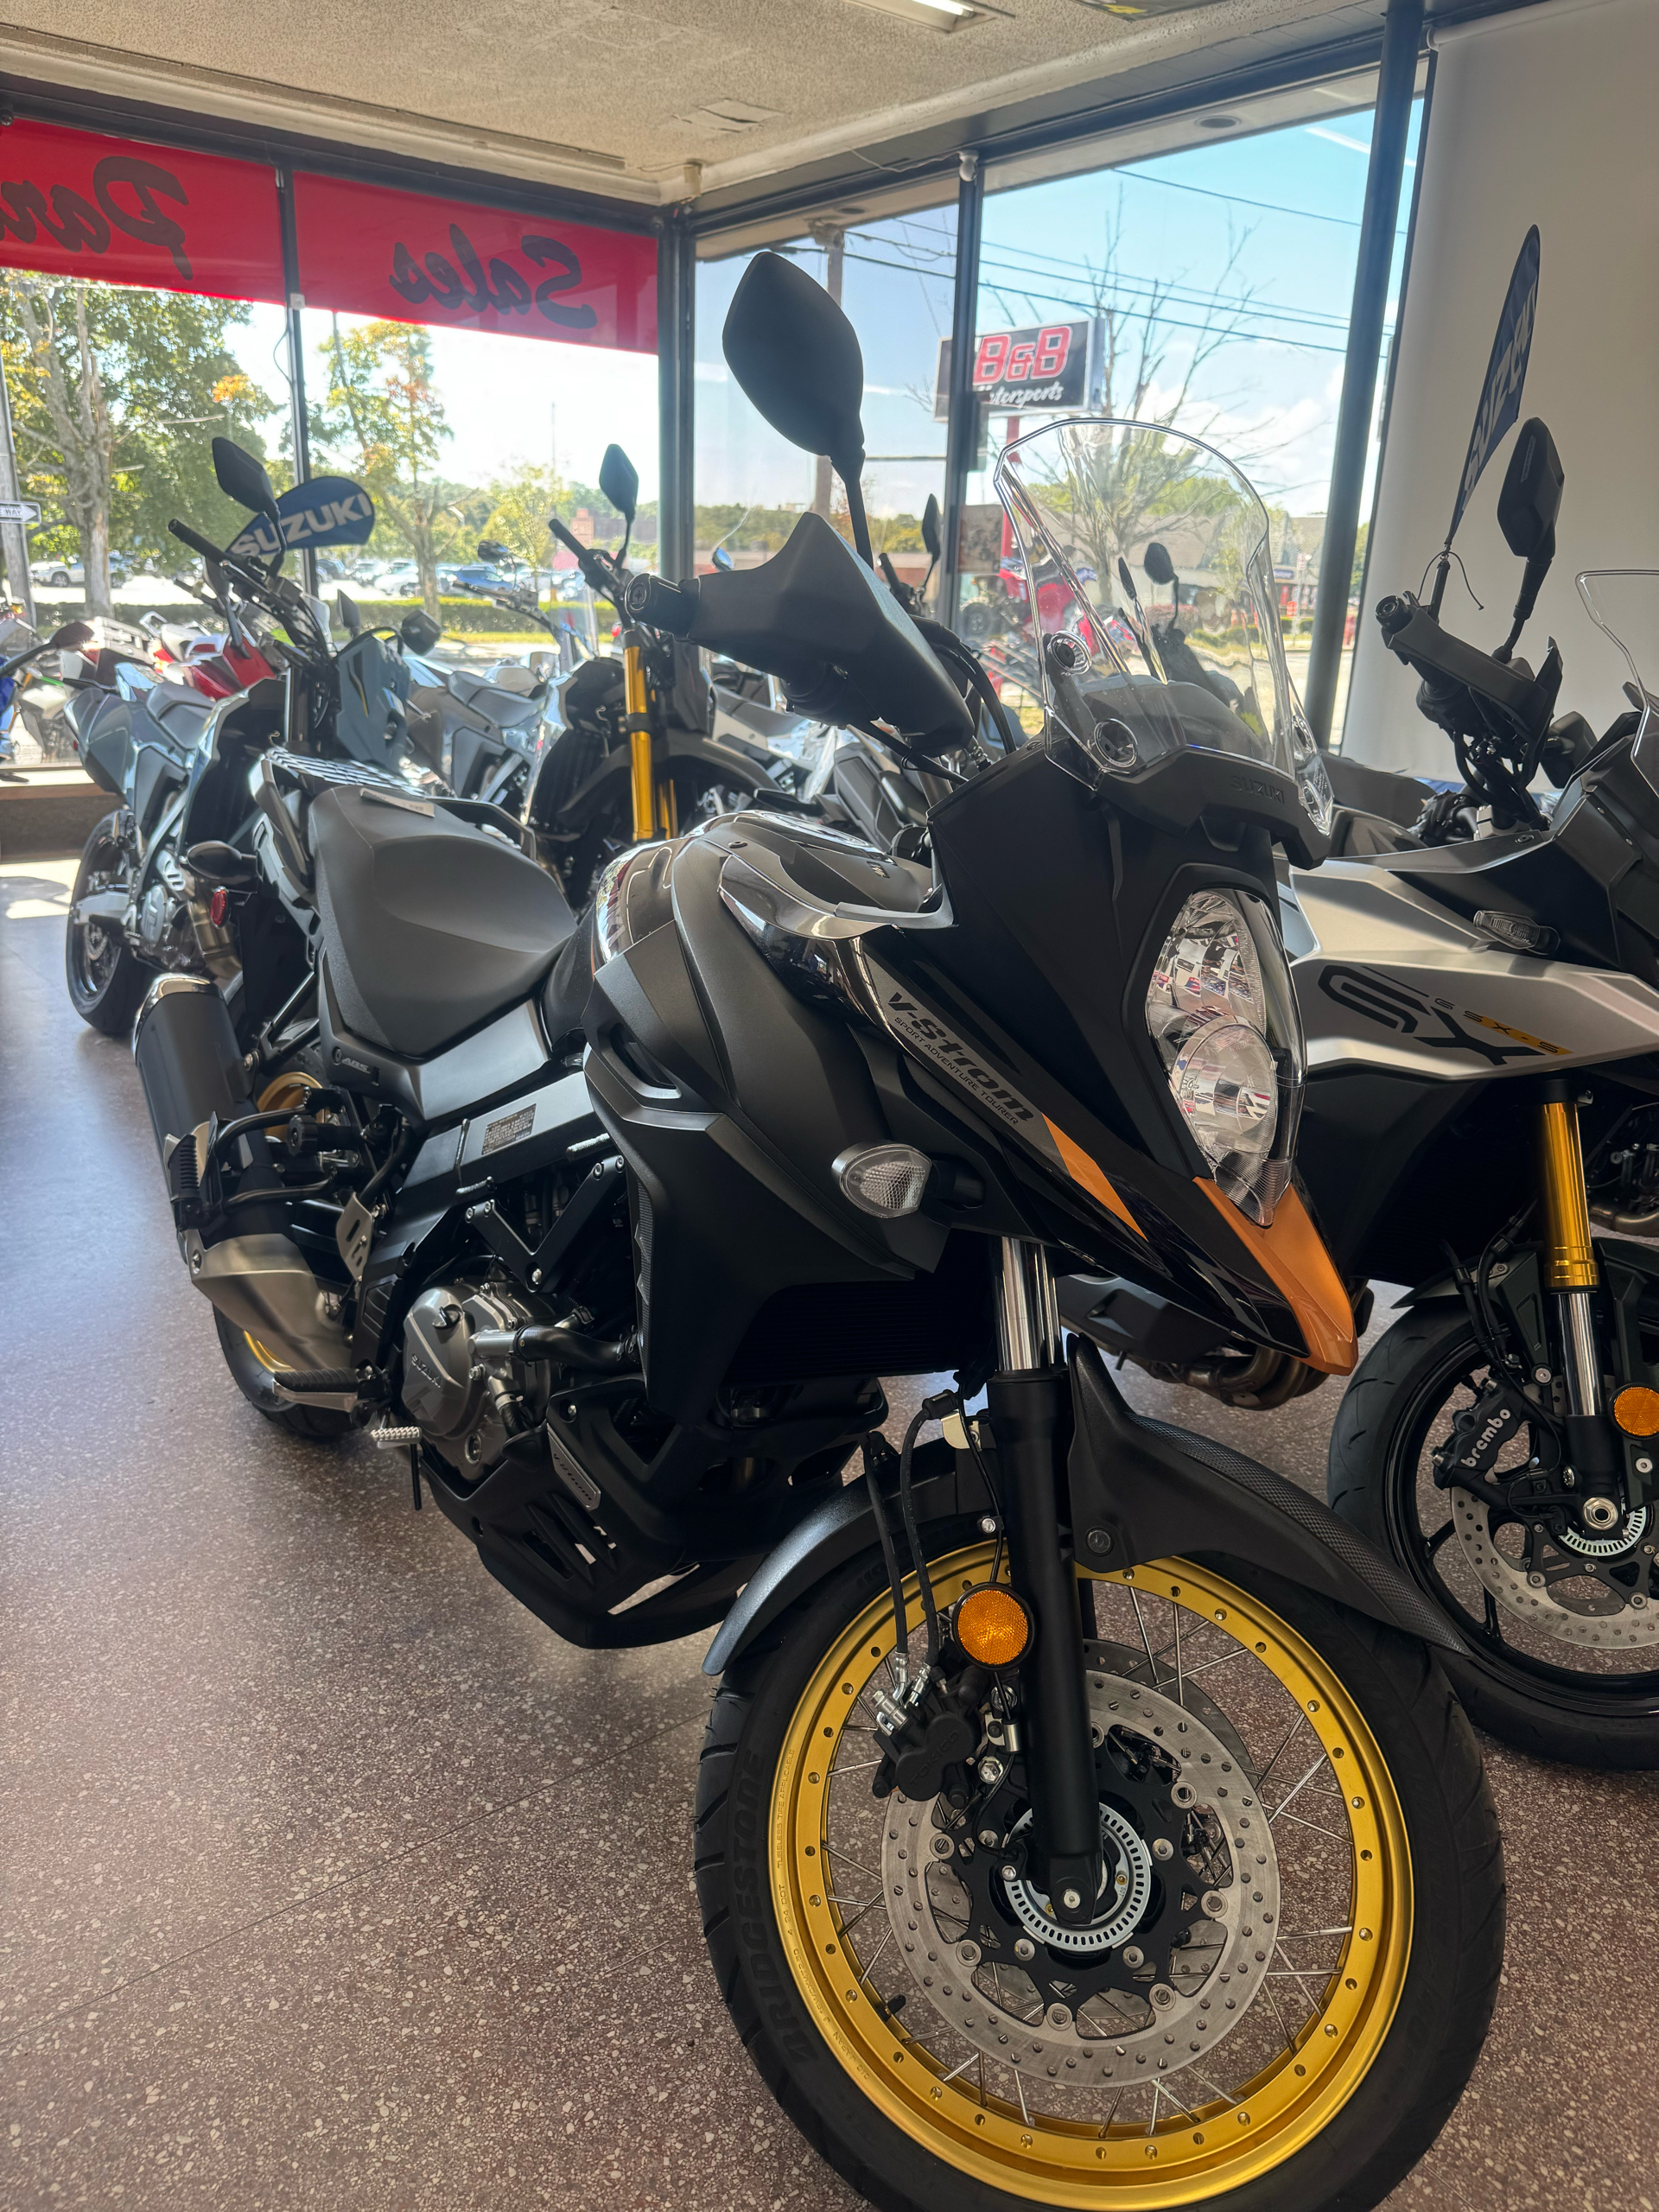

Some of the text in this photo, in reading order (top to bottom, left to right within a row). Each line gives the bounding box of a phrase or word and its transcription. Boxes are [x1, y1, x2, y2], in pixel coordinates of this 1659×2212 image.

[973, 326, 1073, 385] B&B
[978, 381, 1065, 410] torsports
[222, 493, 373, 558] SUZUKI
[1230, 775, 1286, 804] SUZUKI
[342, 1058, 371, 1074] ABS
[887, 992, 1034, 1122] V-Strom
[894, 1017, 1019, 1125] SPORT ADVENTURE TOURER
[1460, 1408, 1510, 1467] brembo
[779, 1749, 795, 1799] APPLICABLE
[910, 1731, 958, 1786] TOKICO
[734, 1748, 819, 2065] BRIDGESTONE
[779, 1884, 788, 1905] DOT
